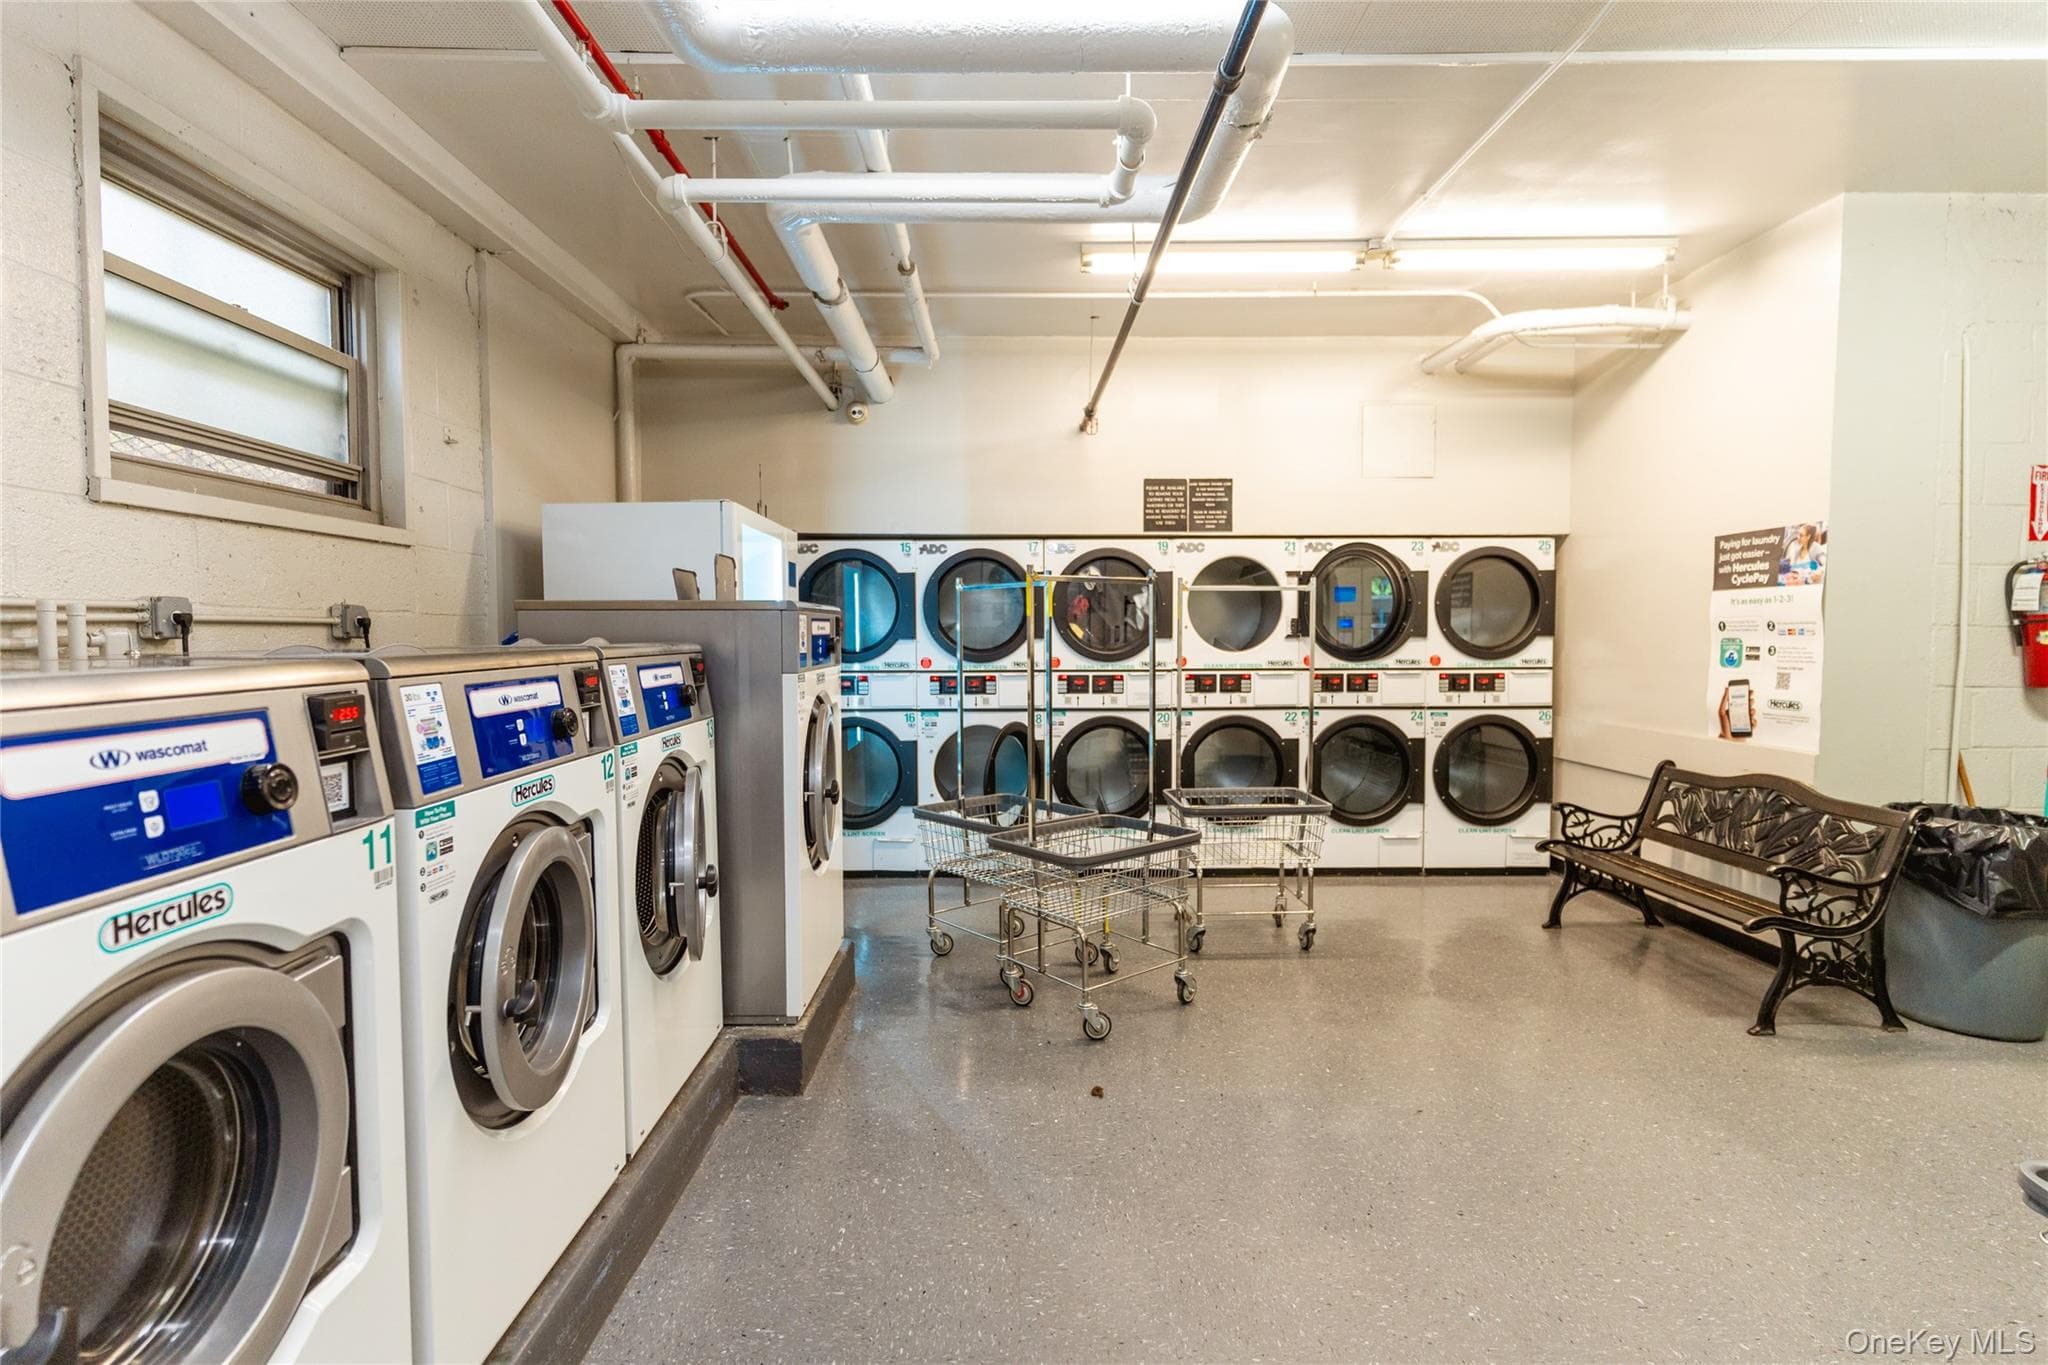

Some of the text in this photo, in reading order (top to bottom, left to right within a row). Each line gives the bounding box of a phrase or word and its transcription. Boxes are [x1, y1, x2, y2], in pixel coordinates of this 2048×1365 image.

[1027, 542, 1038, 551] 17
[1157, 542, 1168, 551] 19
[1284, 541, 1296, 551] 21
[1411, 541, 1424, 551] 23
[1432, 542, 1459, 552] ADC
[1539, 540, 1551, 550] 25
[1720, 534, 1780, 550] Paying for laundry
[900, 543, 911, 552] 15
[919, 544, 948, 554] ADC
[1177, 543, 1205, 553] ADC
[1731, 552, 1742, 562] got
[1743, 549, 1764, 559] easier
[1732, 561, 1770, 572] Hercules
[1731, 574, 1770, 586] CyclePay
[1770, 700, 1800, 710] Hercules
[905, 713, 915, 723] 16
[1158, 713, 1169, 723] 20
[1285, 712, 1297, 721] 22
[1411, 712, 1423, 720] 24
[1539, 711, 1551, 720] 26
[135, 740, 208, 762] wascomat
[601, 753, 614, 780] 12
[514, 777, 552, 802] Hercules
[363, 824, 391, 870] 11
[113, 890, 226, 944] Hercules
